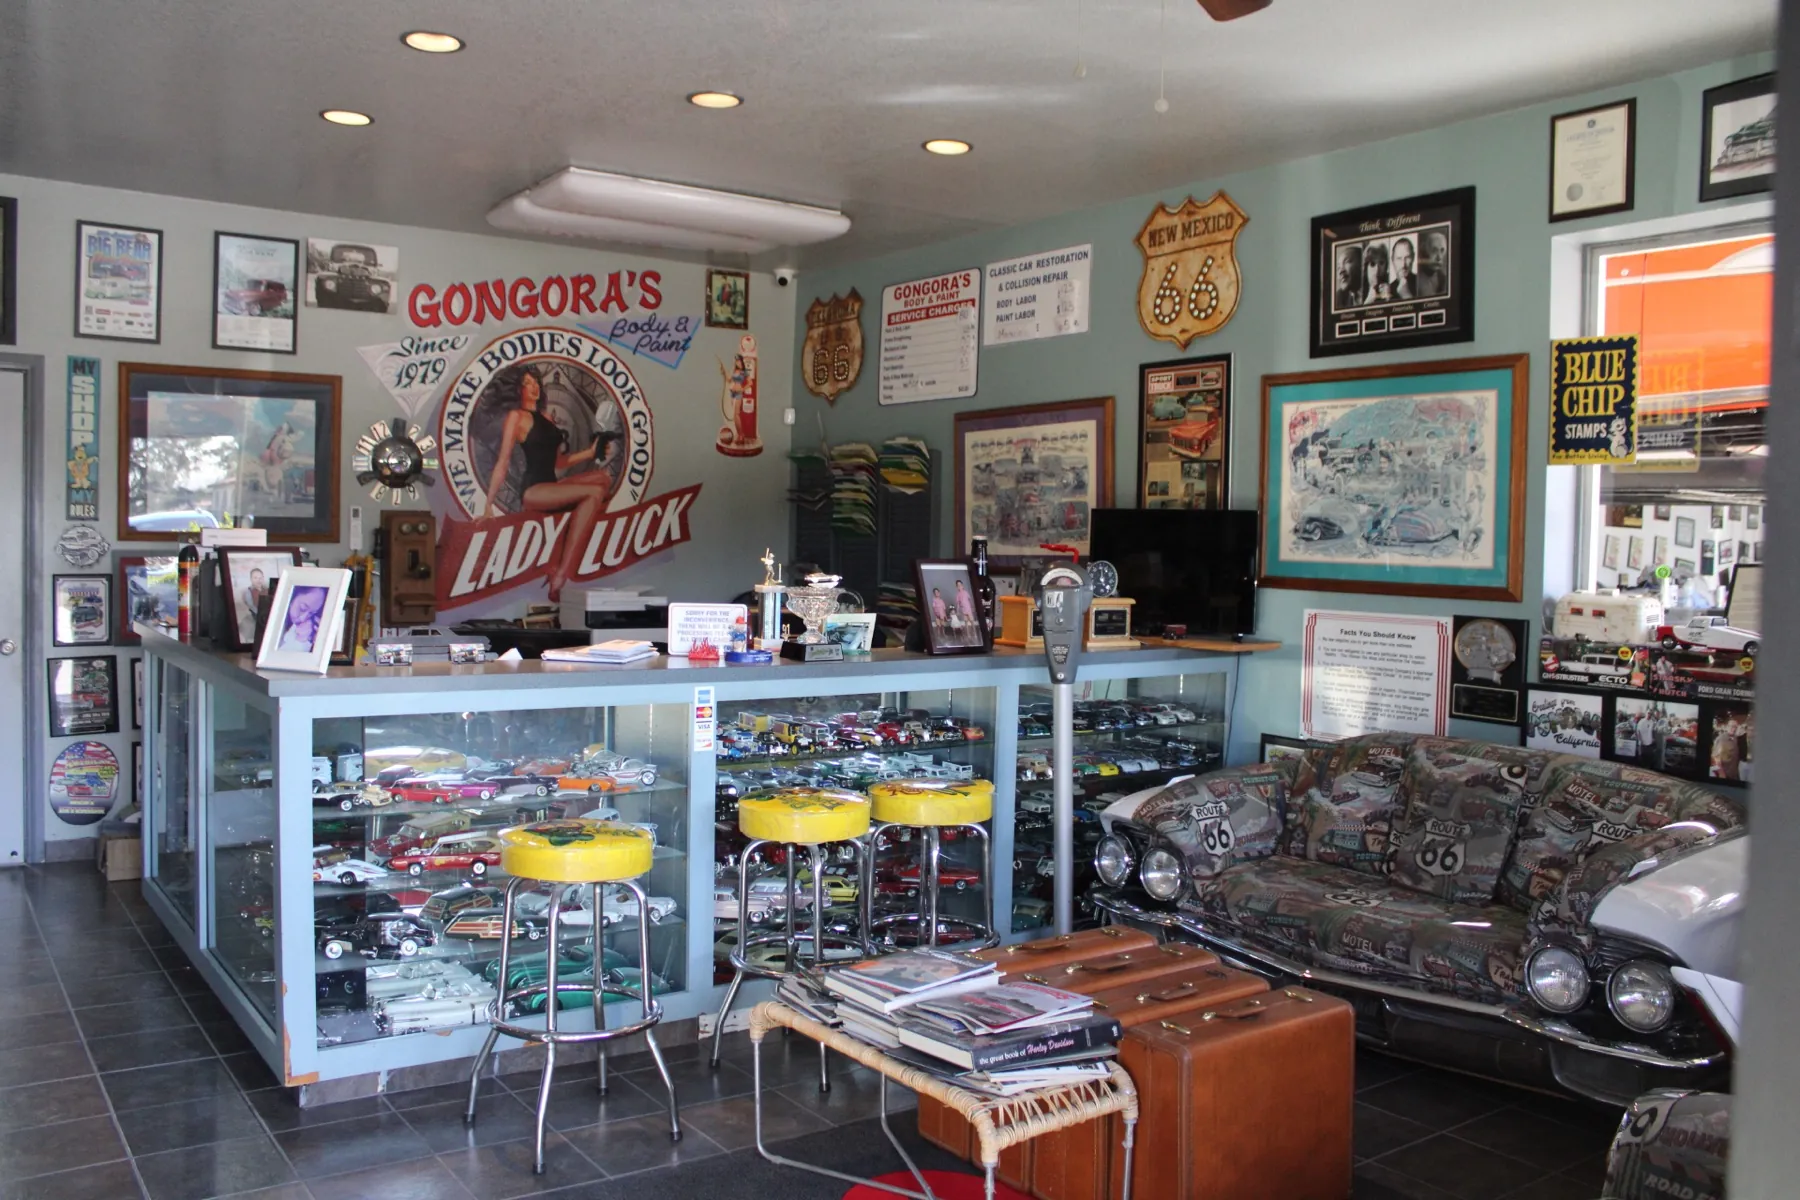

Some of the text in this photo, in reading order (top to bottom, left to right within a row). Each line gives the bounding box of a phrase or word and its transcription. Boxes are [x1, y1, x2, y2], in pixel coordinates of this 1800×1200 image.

[1148, 212, 1234, 249] NEW MEXICO
[1360, 214, 1421, 233] Think Different
[989, 250, 1090, 278] CLASSIC CAR RESTORATION
[893, 273, 971, 301] GONGORA'S
[1005, 275, 1042, 291] COLLISION
[1042, 270, 1069, 284] REPAIR
[1153, 255, 1220, 326] 66
[407, 269, 664, 329] GONGORA'S
[904, 290, 961, 309] BODY & PAINT
[996, 294, 1037, 309] BODY LABOR
[675, 316, 689, 333] &
[890, 309, 927, 324] SERVICE
[996, 309, 1036, 323] PAINT LABOR
[387, 335, 469, 358] Since
[632, 333, 692, 355] Paint
[73, 359, 96, 376] MY
[394, 357, 446, 389] 1979
[813, 343, 850, 386] 66
[1561, 348, 1627, 385] BLUE
[445, 371, 484, 453] MAKE
[478, 331, 584, 375] BODIES
[586, 345, 642, 409] LOOK
[1561, 383, 1626, 419] CHIP
[1564, 421, 1608, 440] STAMPS
[69, 503, 96, 518] RULES
[449, 493, 694, 598] LADY LUCK
[1340, 628, 1417, 641] Facts You Should Know
[1598, 674, 1628, 685] ECTO
[1698, 685, 1714, 693] FORD
[1714, 687, 1731, 695] GRAN
[1553, 733, 1601, 748] California
[1368, 747, 1395, 756] MOTEL
[1566, 784, 1597, 804] MOTEL
[1195, 804, 1225, 818] ROUTE
[1203, 821, 1230, 851] 66
[1430, 821, 1467, 836] ROUTE
[1598, 823, 1637, 839] ROUTE
[1420, 837, 1459, 872] 66
[1341, 932, 1374, 952] MOTEL
[979, 1038, 1074, 1065] the great book of Harley Davidson
